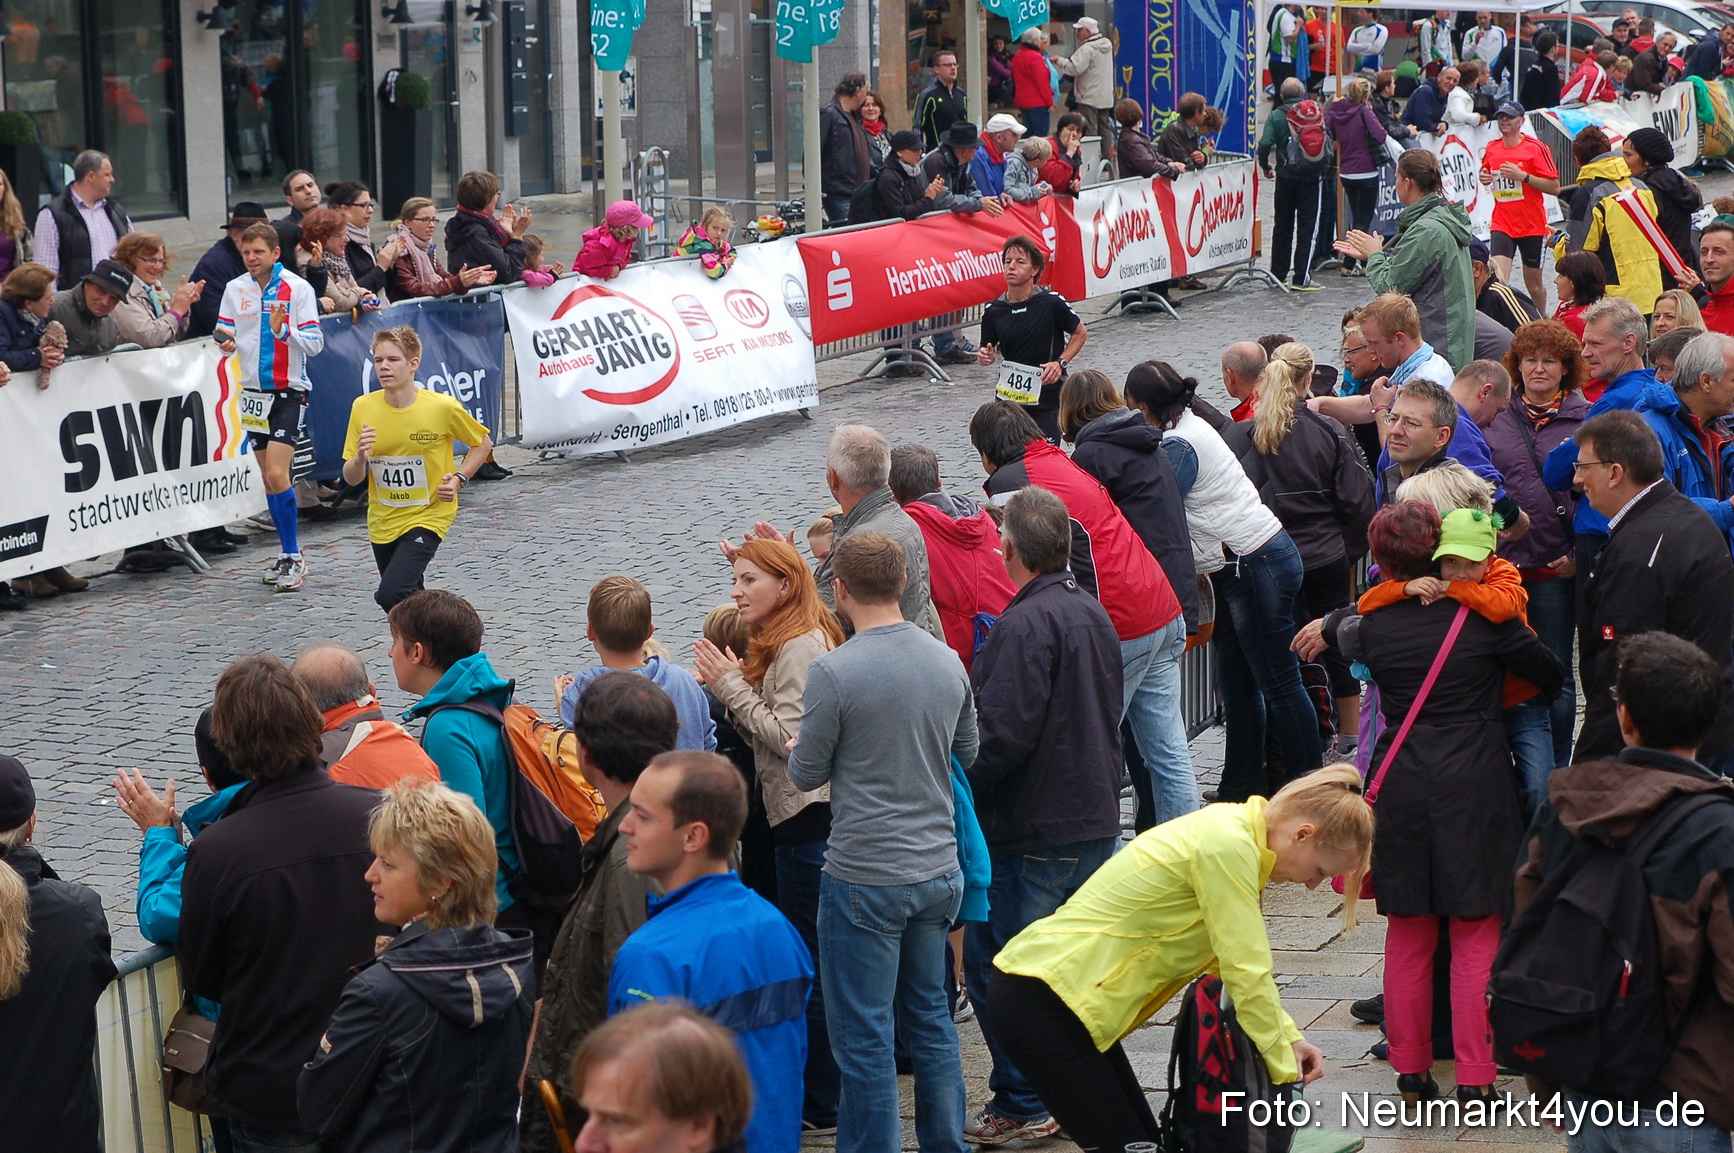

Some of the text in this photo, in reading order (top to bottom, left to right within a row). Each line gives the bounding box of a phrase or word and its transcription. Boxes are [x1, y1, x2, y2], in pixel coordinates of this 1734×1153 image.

[1497, 178, 1515, 190] 119
[885, 257, 951, 297] Herzlich
[730, 298, 764, 320] KIA
[533, 309, 643, 359] GERHART
[741, 330, 794, 351] KIA MOTORS
[595, 332, 672, 375] JÄNIG
[693, 343, 737, 363] SEAT
[538, 353, 596, 378] Autohaus
[1007, 372, 1032, 392] 484
[242, 397, 263, 417] 399
[610, 409, 683, 442] Sengenthal
[692, 402, 712, 423] Tel.
[382, 468, 415, 487] 440
[69, 465, 251, 532] stadtwerke neumarkt
[390, 492, 410, 500] Jakob
